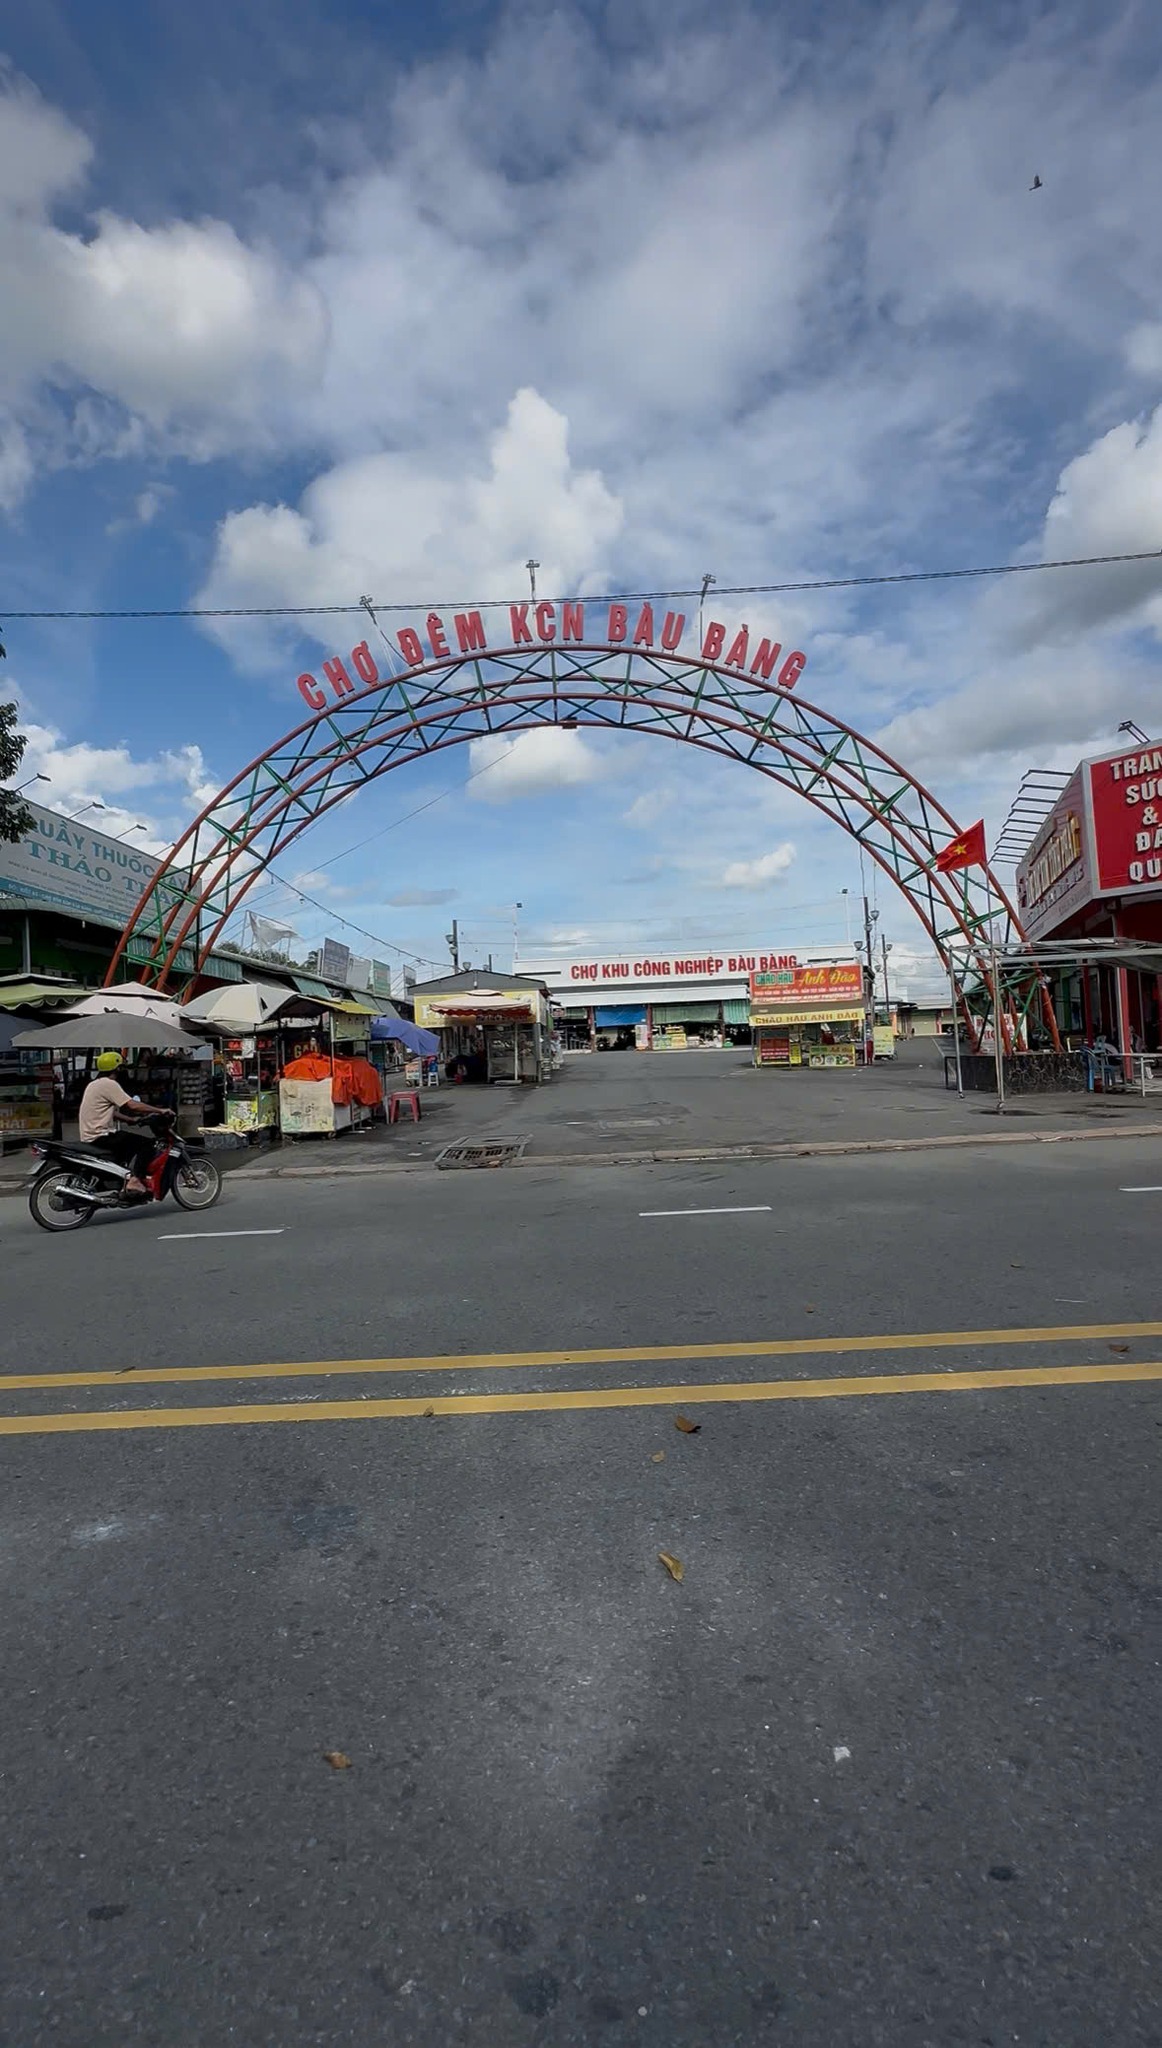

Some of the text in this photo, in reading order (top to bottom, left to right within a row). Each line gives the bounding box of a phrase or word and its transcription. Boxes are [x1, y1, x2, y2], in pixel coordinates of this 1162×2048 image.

[296, 640, 379, 710] CHỢ
[396, 610, 487, 667] ĐÊM
[510, 601, 584, 643] KCN
[608, 601, 686, 650] BÀU
[1142, 806, 1158, 825] &
[24, 838, 112, 882] THẢO
[33, 818, 84, 850] UẦY
[91, 841, 156, 878] THUỐC
[571, 953, 798, 981] CHỢ KHU CÔNG NGHIỆP BÀU BÀNG
